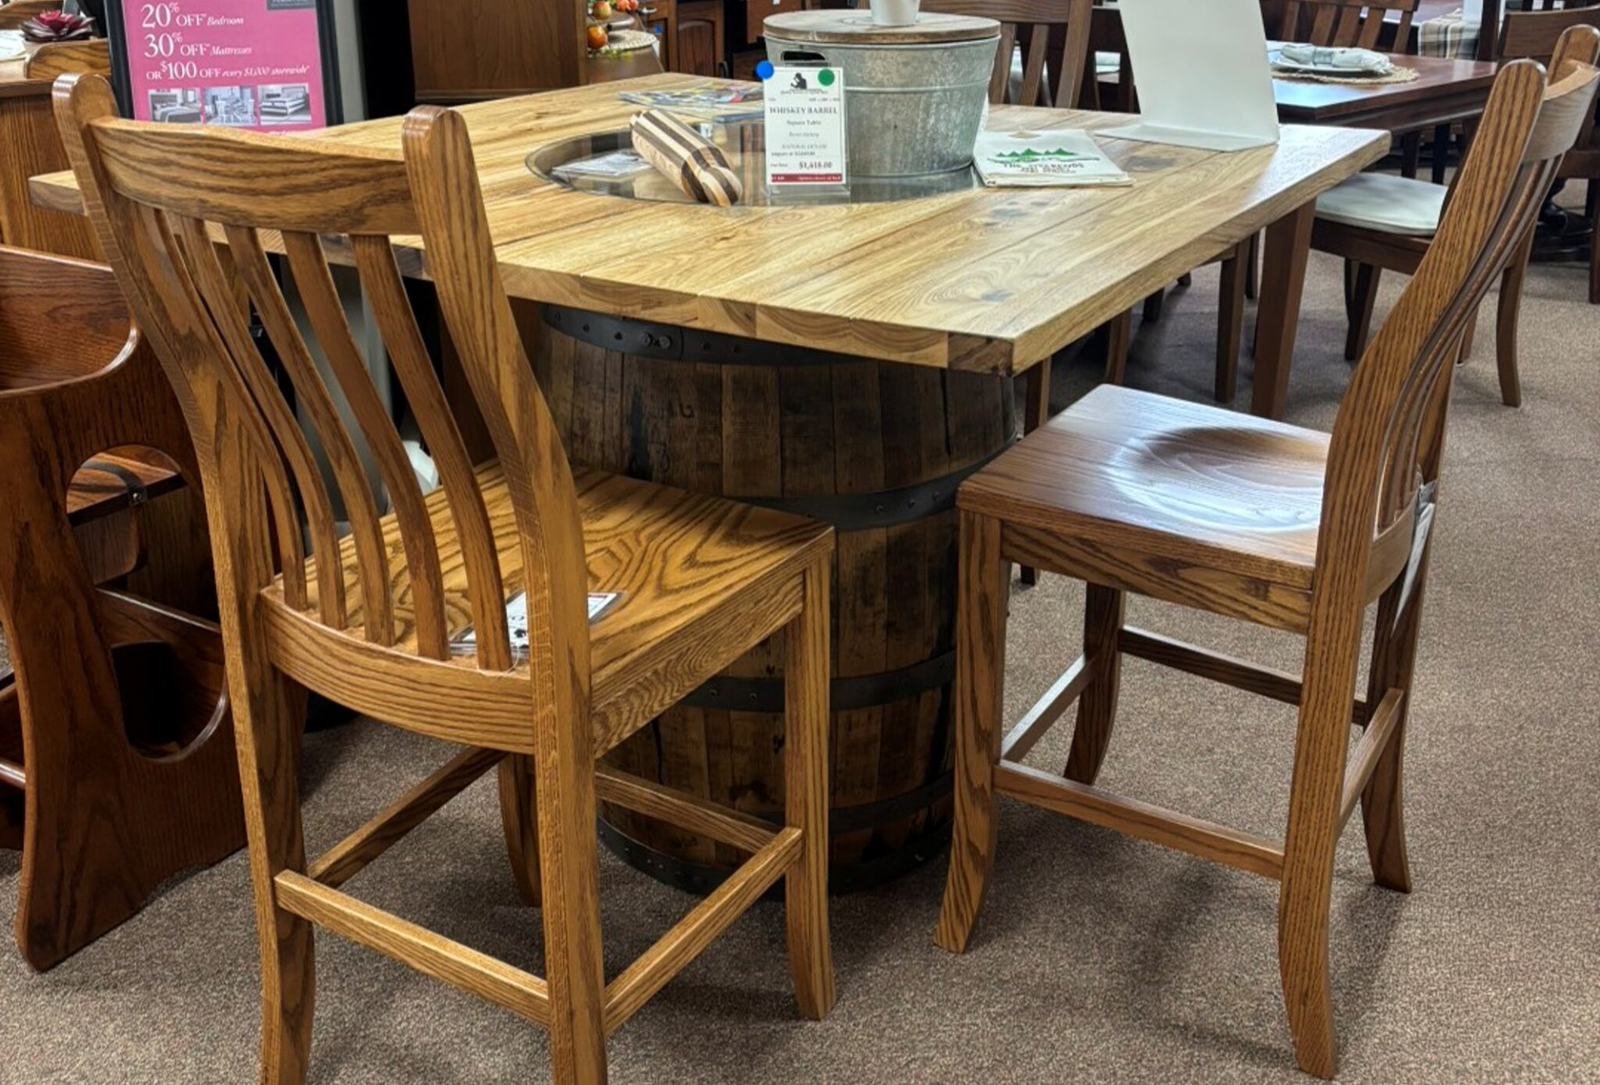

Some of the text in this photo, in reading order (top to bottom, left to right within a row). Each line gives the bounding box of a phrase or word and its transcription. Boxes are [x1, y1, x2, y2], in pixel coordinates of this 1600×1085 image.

[140, 2, 180, 28] 20%
[206, 15, 244, 26] Bedroom
[144, 32, 183, 58] 30%
[210, 46, 252, 56] Mattresses
[146, 71, 162, 80] OR
[160, 60, 197, 80] $100
[199, 68, 221, 77] OFF
[769, 106, 838, 114] WHISKEY BARREL
